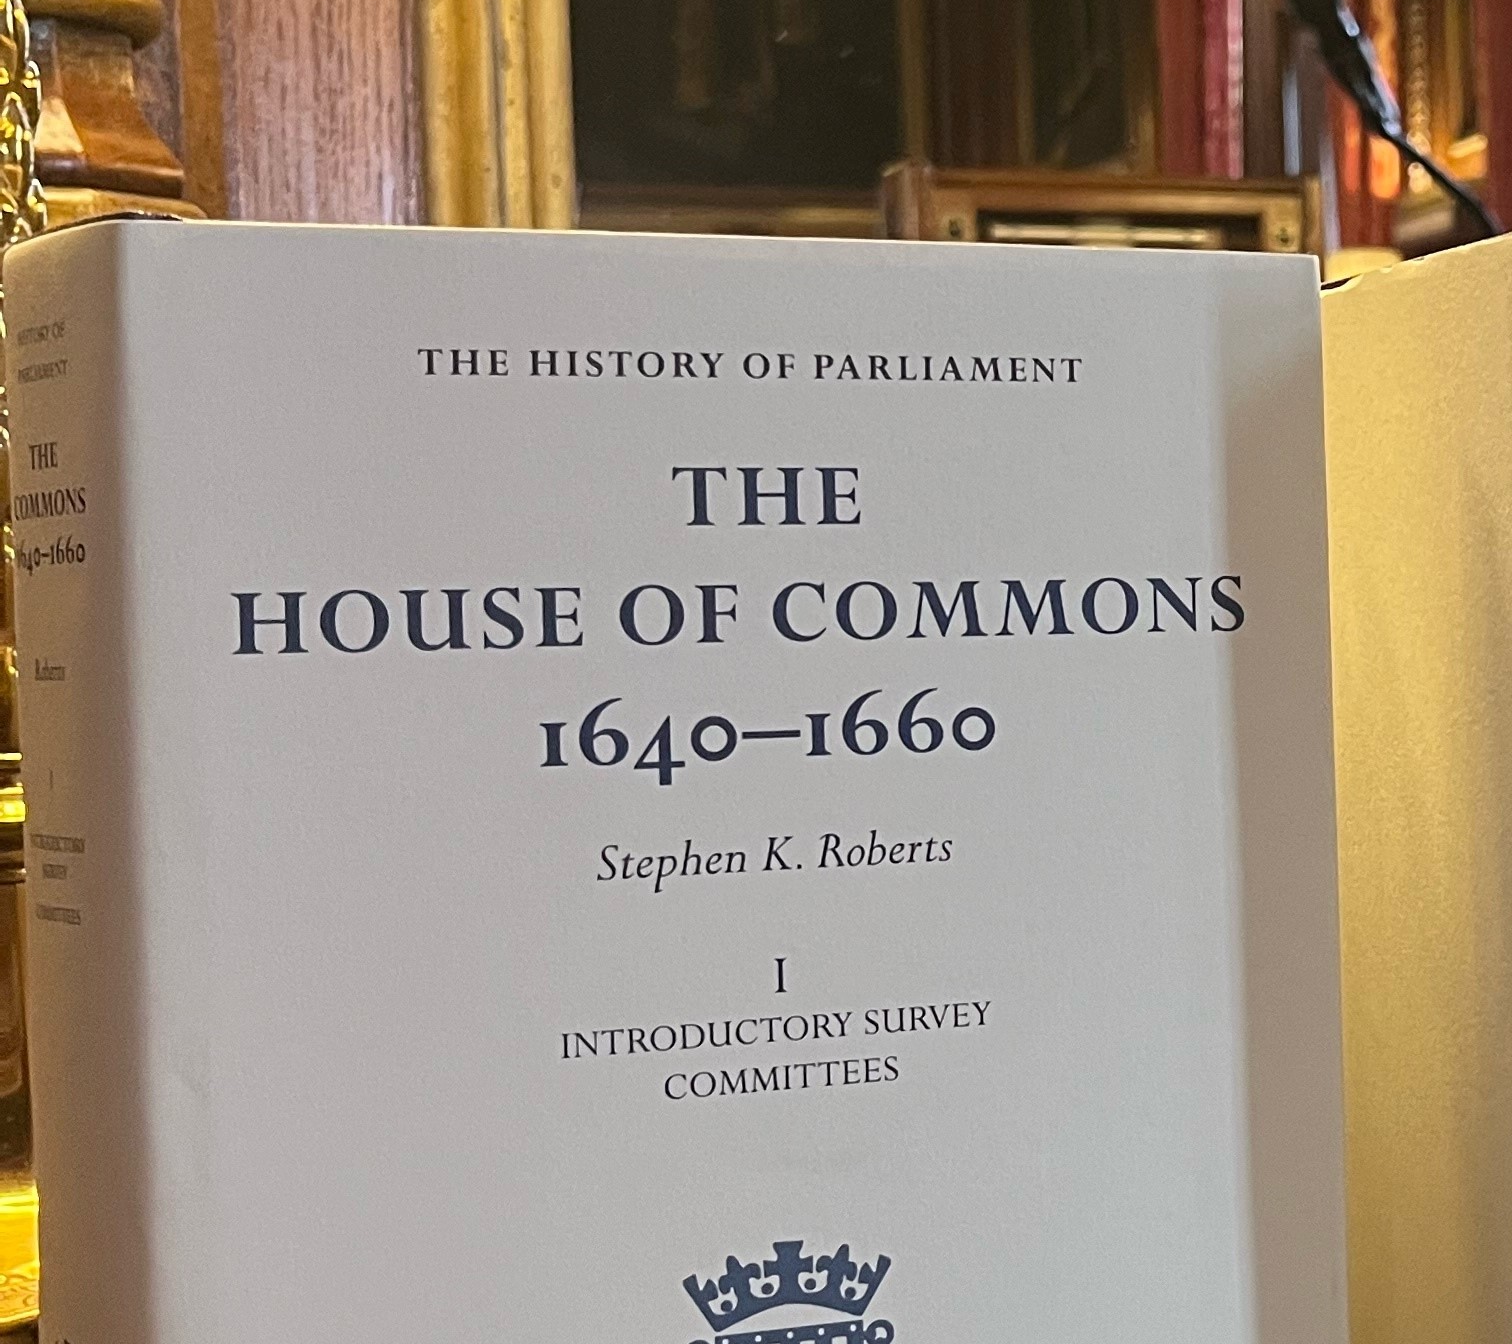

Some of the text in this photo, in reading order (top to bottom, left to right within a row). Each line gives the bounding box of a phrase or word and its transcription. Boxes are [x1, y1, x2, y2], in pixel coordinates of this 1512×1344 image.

[417, 348, 1083, 383] THE HISTORY OF PARLIAMENT
[28, 441, 58, 470] THE
[14, 487, 87, 521] COMMONS
[671, 466, 862, 527] THE
[16, 535, 86, 576] 640–1660
[230, 575, 1245, 656] HOUSE OF COMMONS
[596, 829, 953, 894] Stephen K. Roberts
[774, 957, 787, 994] I
[561, 1000, 991, 1061] INTRODUCTORY SURVEY
[664, 1055, 899, 1101] COMMITTEES
